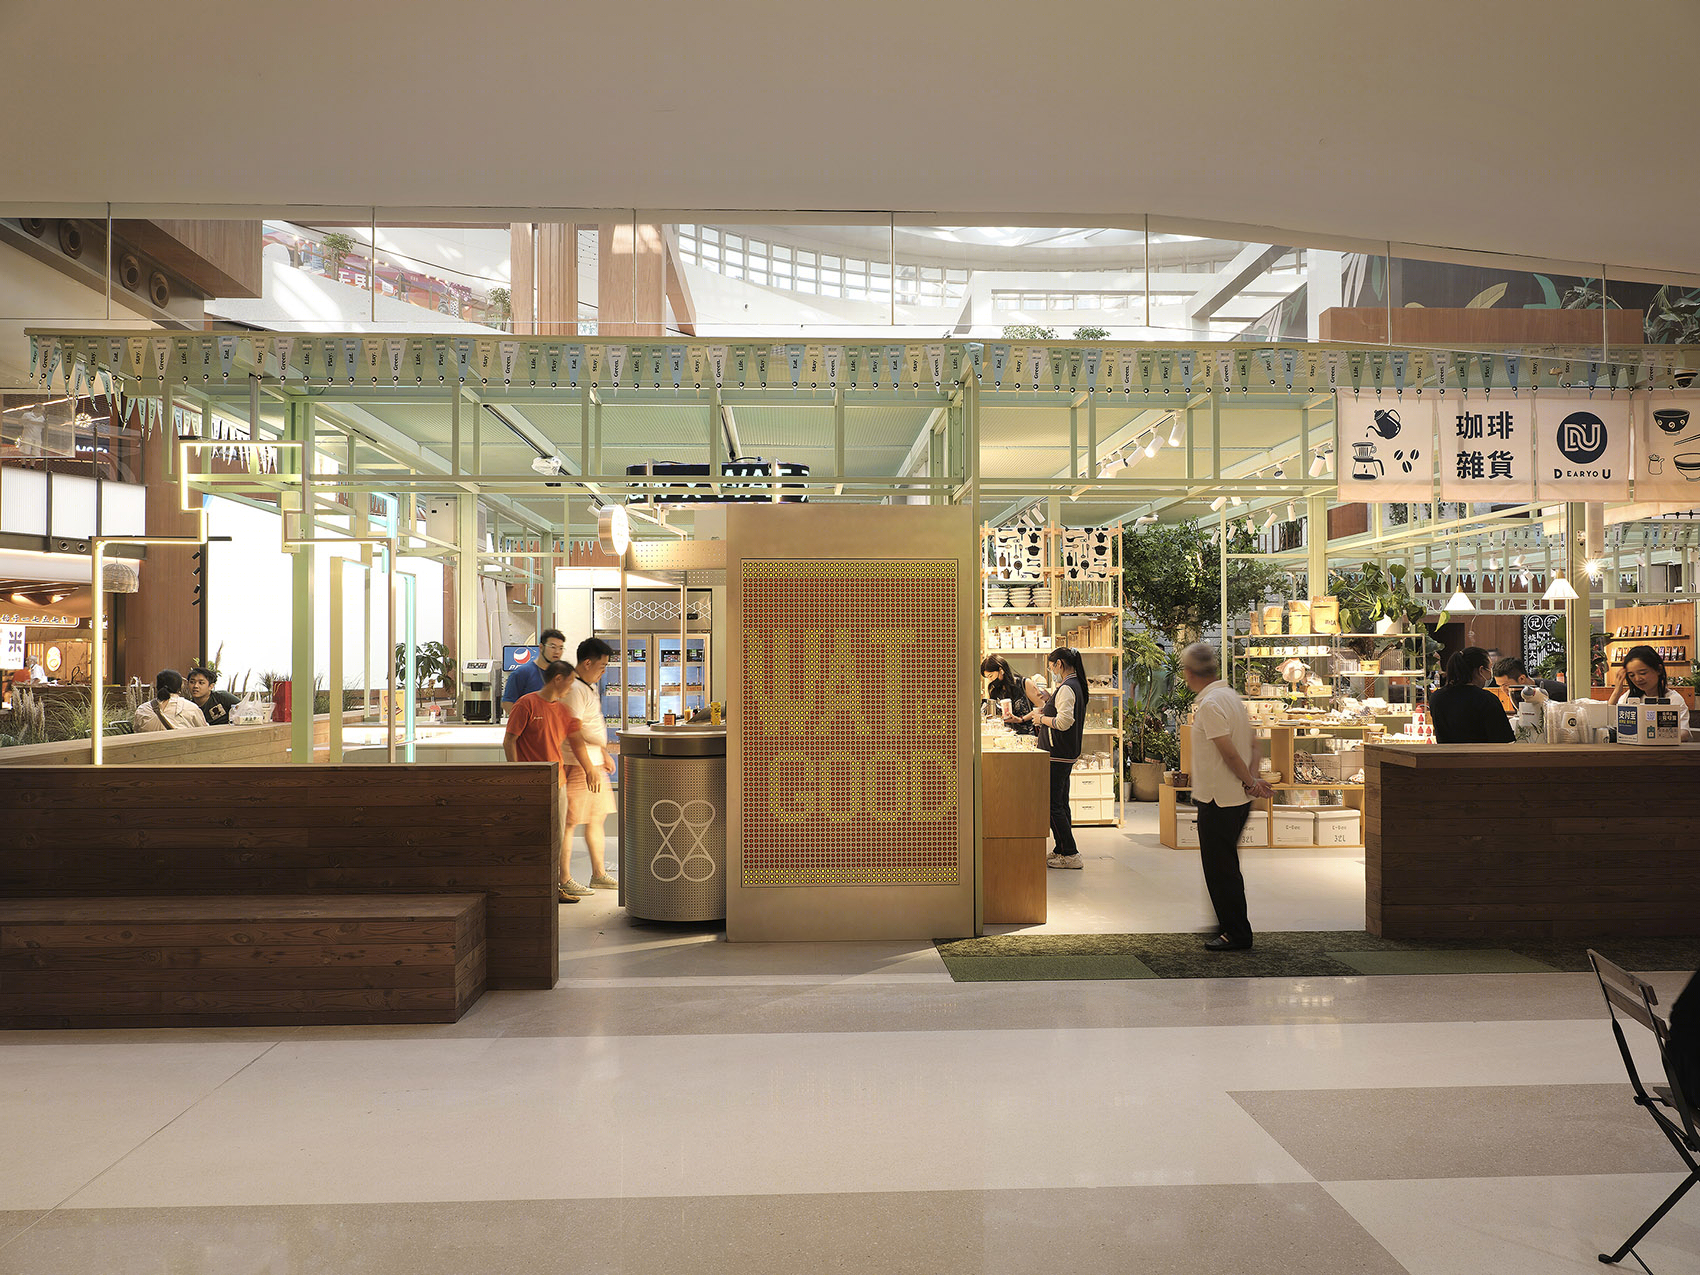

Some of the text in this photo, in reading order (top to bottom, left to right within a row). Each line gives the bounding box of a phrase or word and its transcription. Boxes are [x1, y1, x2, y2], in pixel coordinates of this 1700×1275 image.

[1455, 410, 1514, 440] 珈琲
[1456, 450, 1514, 479] 雜貨
[742, 627, 916, 736] WAT
[1618, 710, 1637, 721] 支付宝
[768, 750, 958, 823] GOOD
